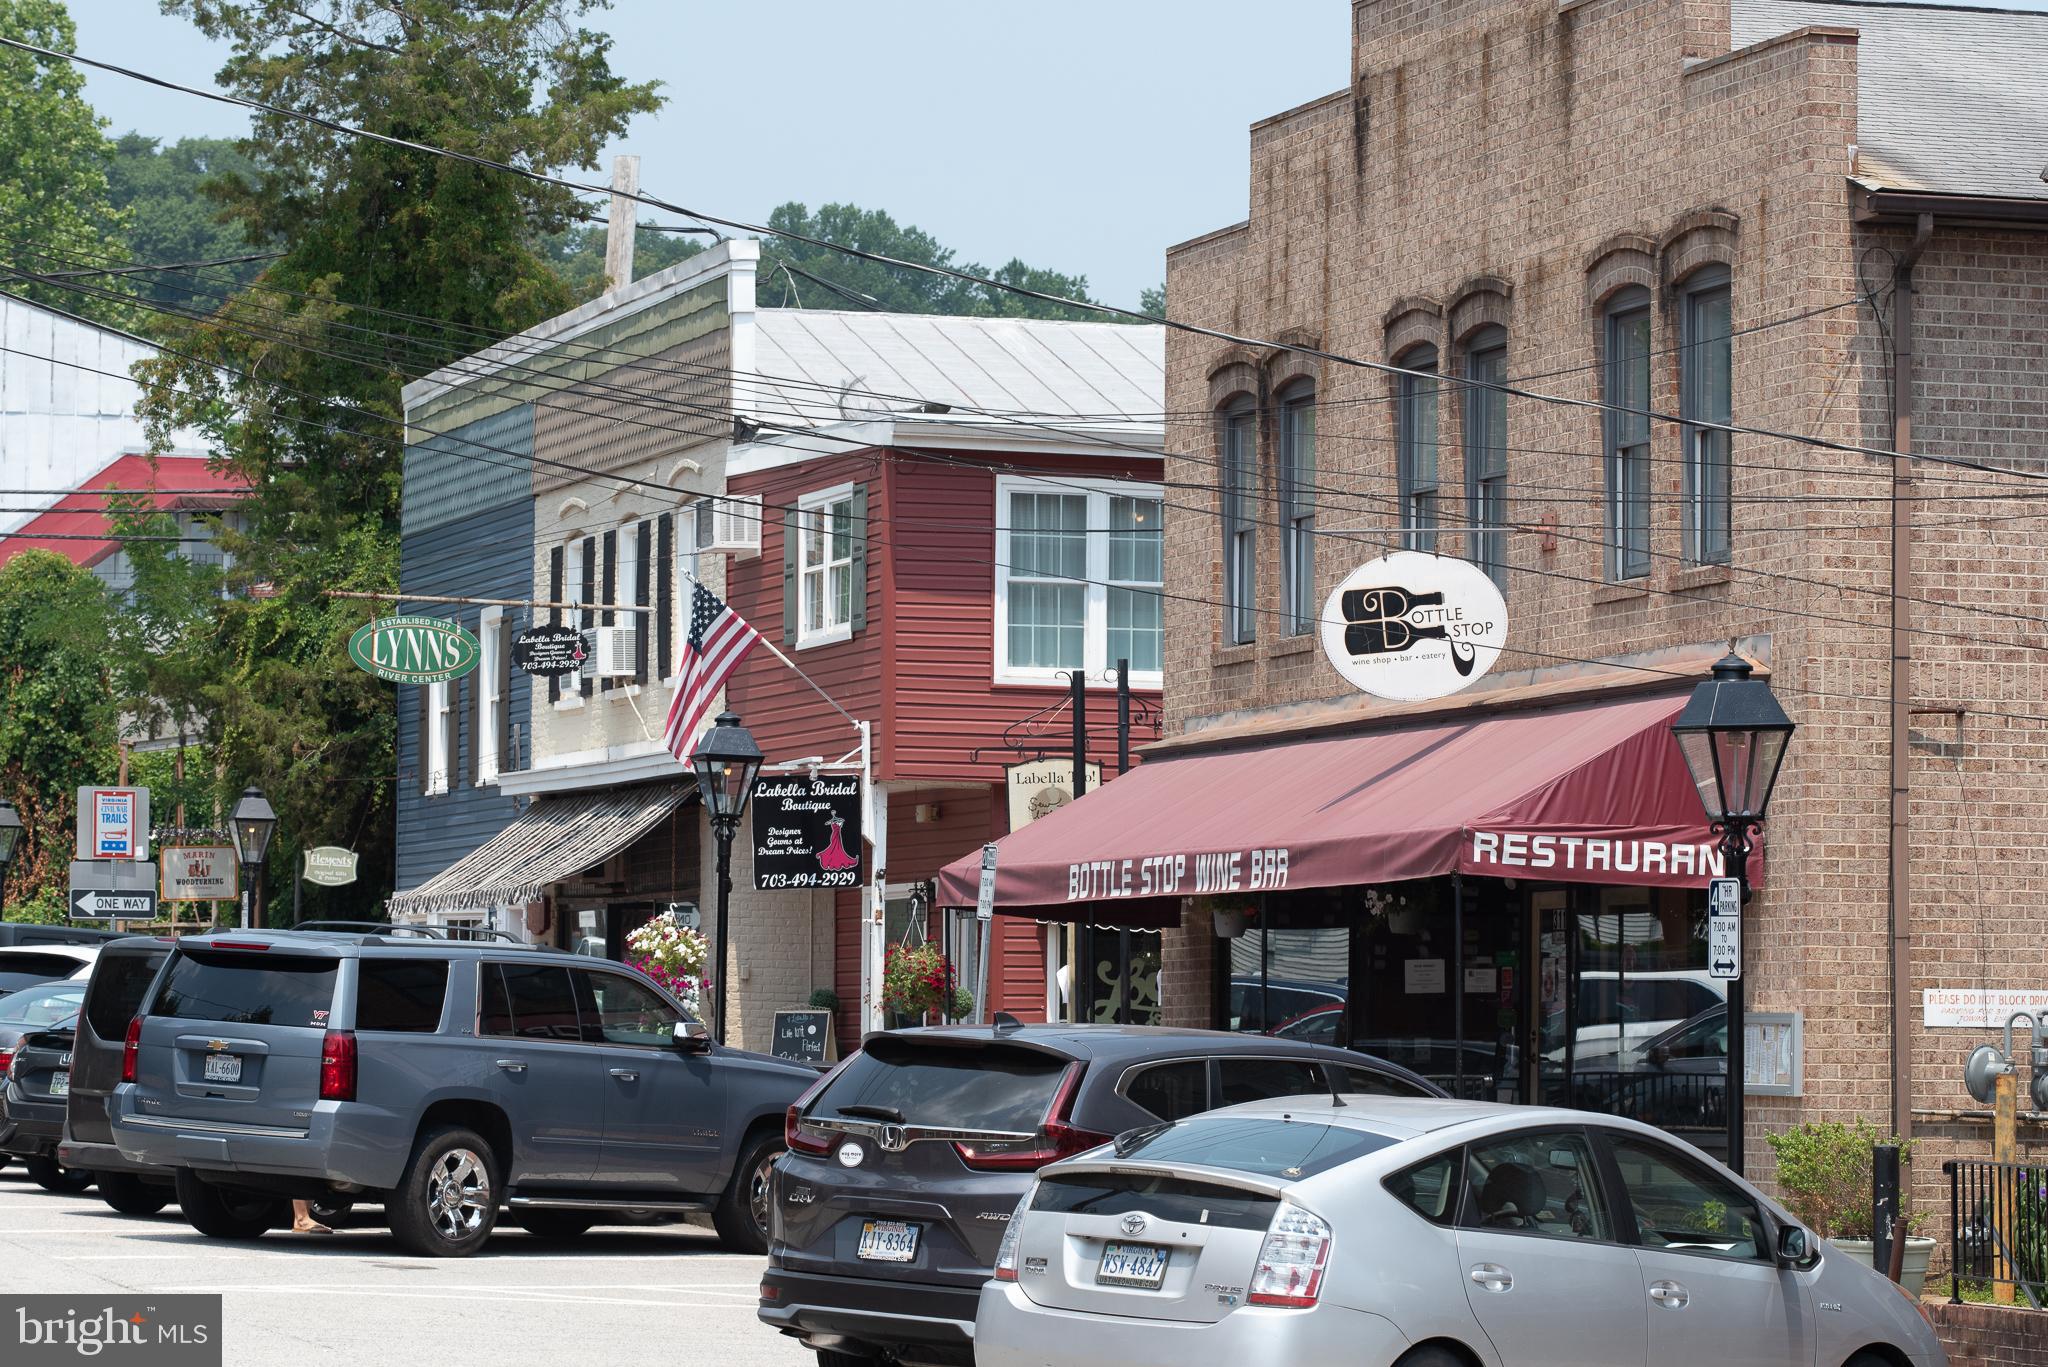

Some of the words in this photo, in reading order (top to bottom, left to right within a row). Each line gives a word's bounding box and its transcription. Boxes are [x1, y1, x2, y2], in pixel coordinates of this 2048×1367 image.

[381, 617, 431, 627] ESTABLISED
[433, 620, 451, 630] 1917
[1453, 621, 1494, 637] STOP
[552, 633, 580, 642] Bridal
[373, 628, 460, 671] LYNN'S
[534, 643, 565, 651] Boutique
[1351, 658, 1371, 666] wine
[1373, 655, 1392, 666] shop
[1400, 653, 1413, 662] bar
[1421, 651, 1447, 662] eatery
[522, 660, 580, 670] 703-494-2929
[377, 668, 408, 682] RIVER
[411, 672, 452, 683] CENTER
[1015, 772, 1064, 785] Labella
[754, 782, 807, 797] Labella
[810, 780, 857, 796] Bridal
[781, 798, 832, 813] Boutique
[101, 813, 128, 824] TRAILS
[768, 826, 801, 838] Designer
[767, 836, 792, 848] Gowns
[794, 837, 803, 845] at
[758, 847, 784, 856] Dream
[786, 846, 813, 855] Prices!
[1473, 831, 1725, 876] RESTAURAN
[761, 871, 856, 888] 703-494-2929
[1067, 859, 1133, 900] BOTTLE
[1139, 854, 1186, 895] STOP
[1195, 852, 1242, 893] WINE
[1249, 848, 1289, 889] BAR
[176, 877, 225, 886] WOODTURNING
[96, 898, 120, 909] ONE
[123, 898, 146, 909] WAY
[1711, 887, 1718, 912] 4
[1724, 885, 1733, 898] HR
[1720, 900, 1737, 912] PARKING
[1713, 922, 1726, 932] 7:00
[1727, 922, 1736, 932] AM
[1721, 934, 1728, 943] TO
[1713, 945, 1726, 955] 7:00
[1727, 945, 1736, 955] PM
[1929, 994, 1960, 1005] PLEASE
[1963, 994, 1976, 1005] DO
[1999, 994, 2027, 1006] BLOCK
[1121, 1246, 1153, 1256] VIRGINIA
[1103, 1253, 1165, 1277] WSW-4847
